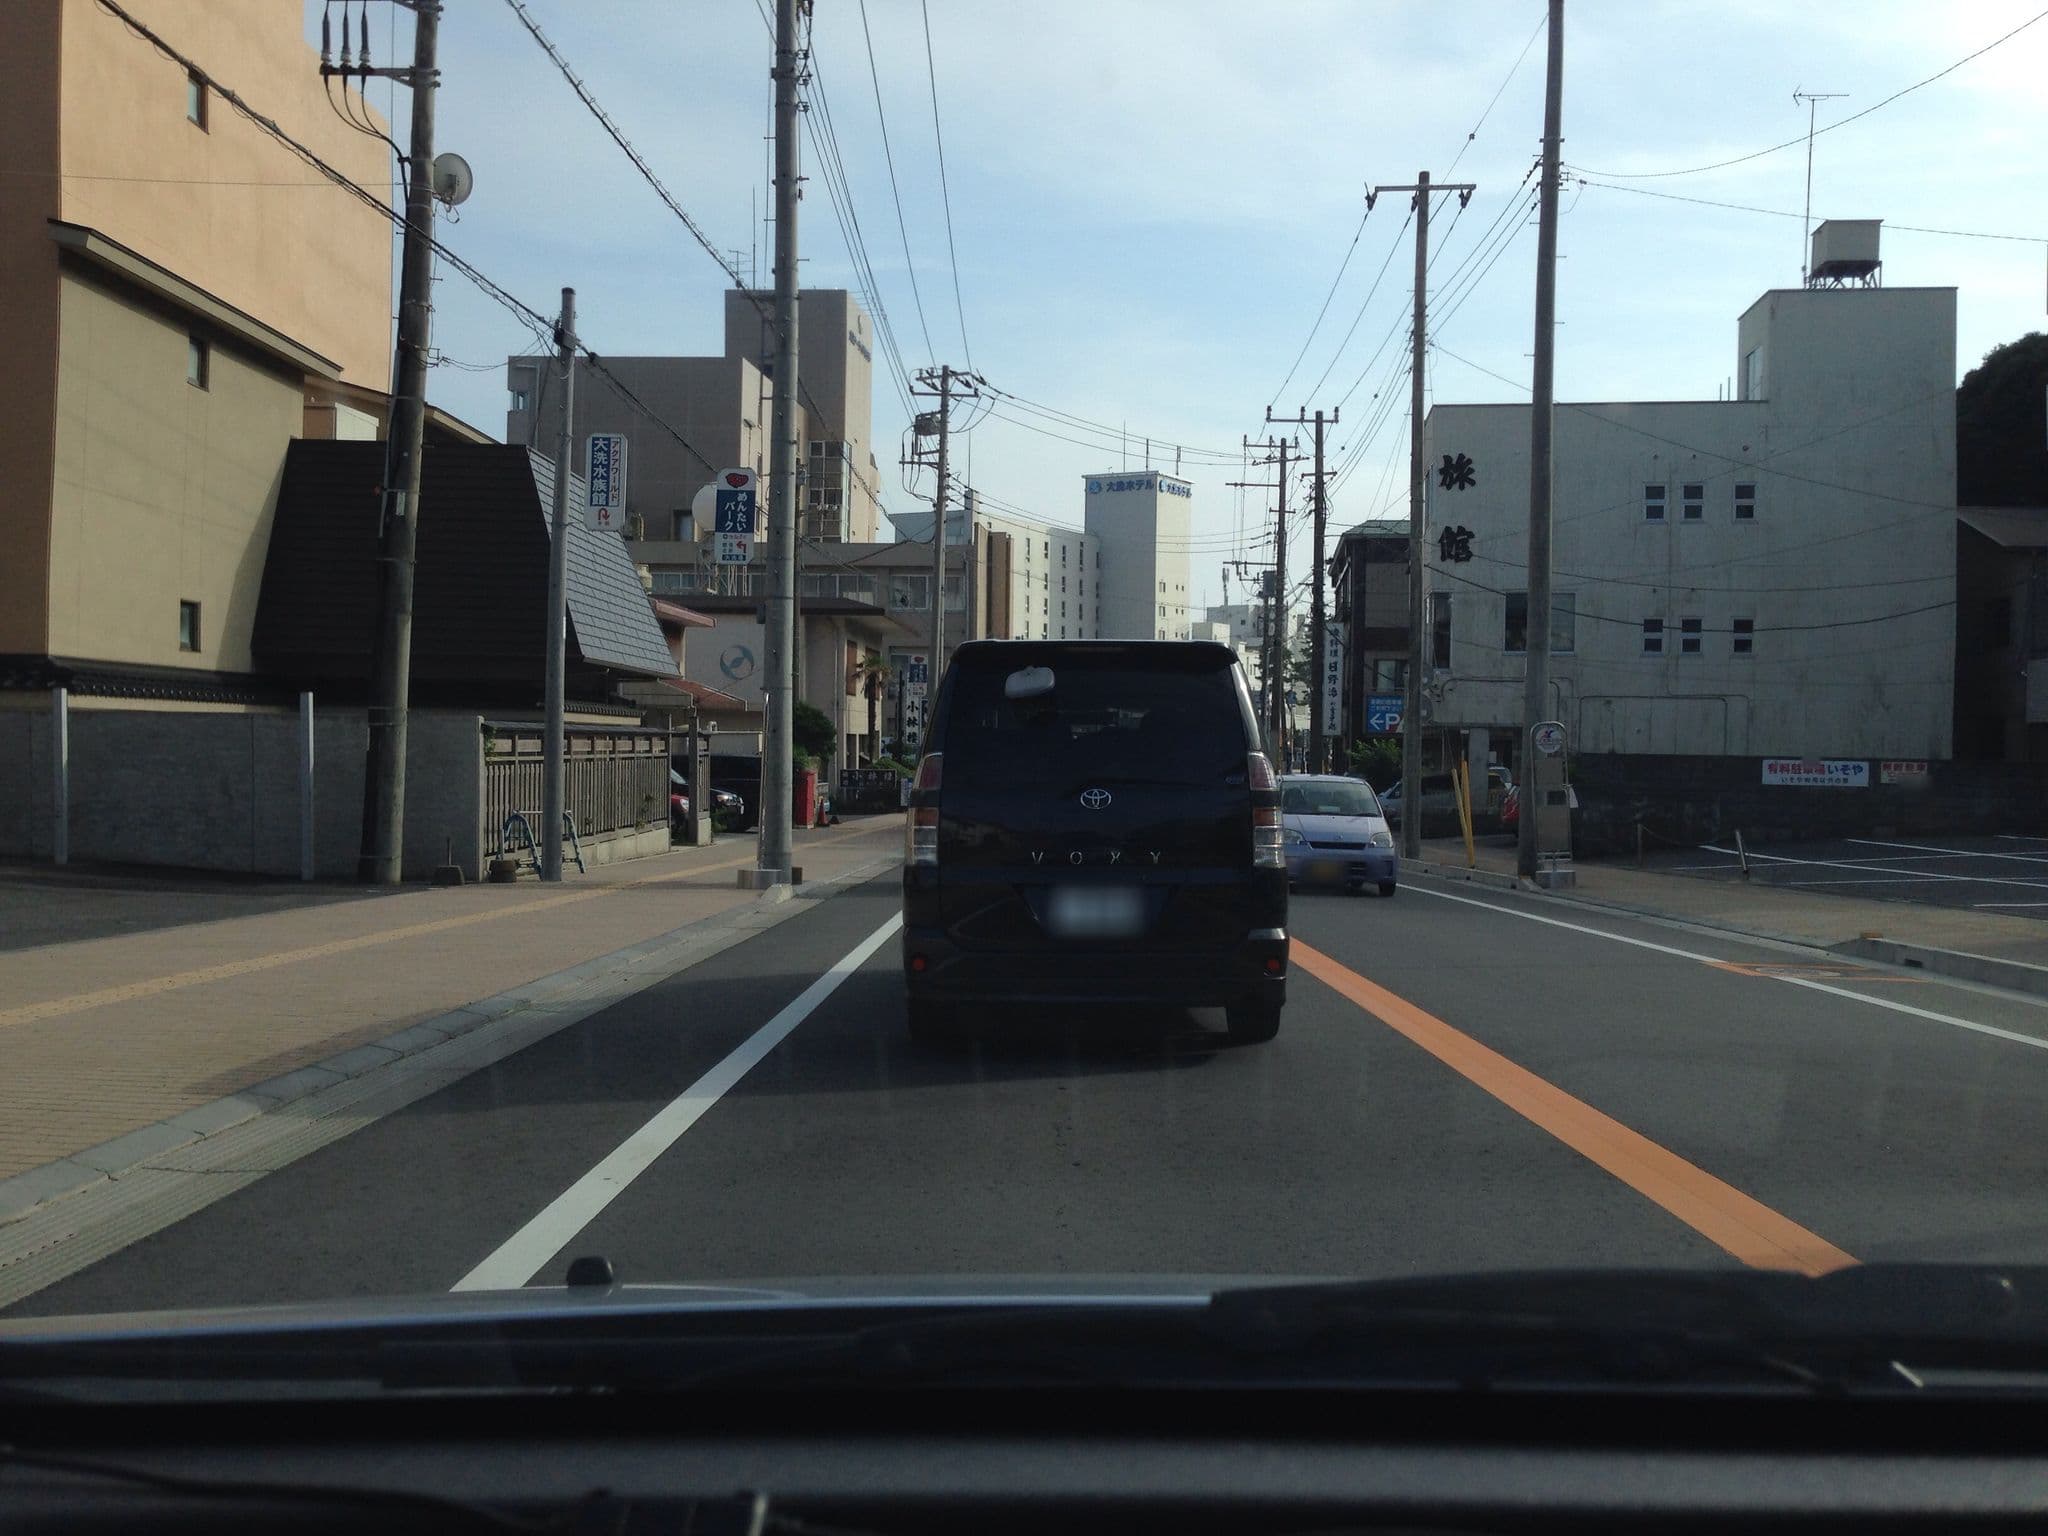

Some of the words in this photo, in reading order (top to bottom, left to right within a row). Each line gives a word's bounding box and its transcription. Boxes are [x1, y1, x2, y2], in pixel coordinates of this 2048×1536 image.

[591, 439, 608, 505] 大洗水族館
[610, 440, 620, 502] アクアワールド
[724, 501, 736, 531] パーク
[736, 492, 748, 531] めんたい
[1438, 453, 1476, 563] 旅館
[1031, 851, 1161, 865] VOXY
